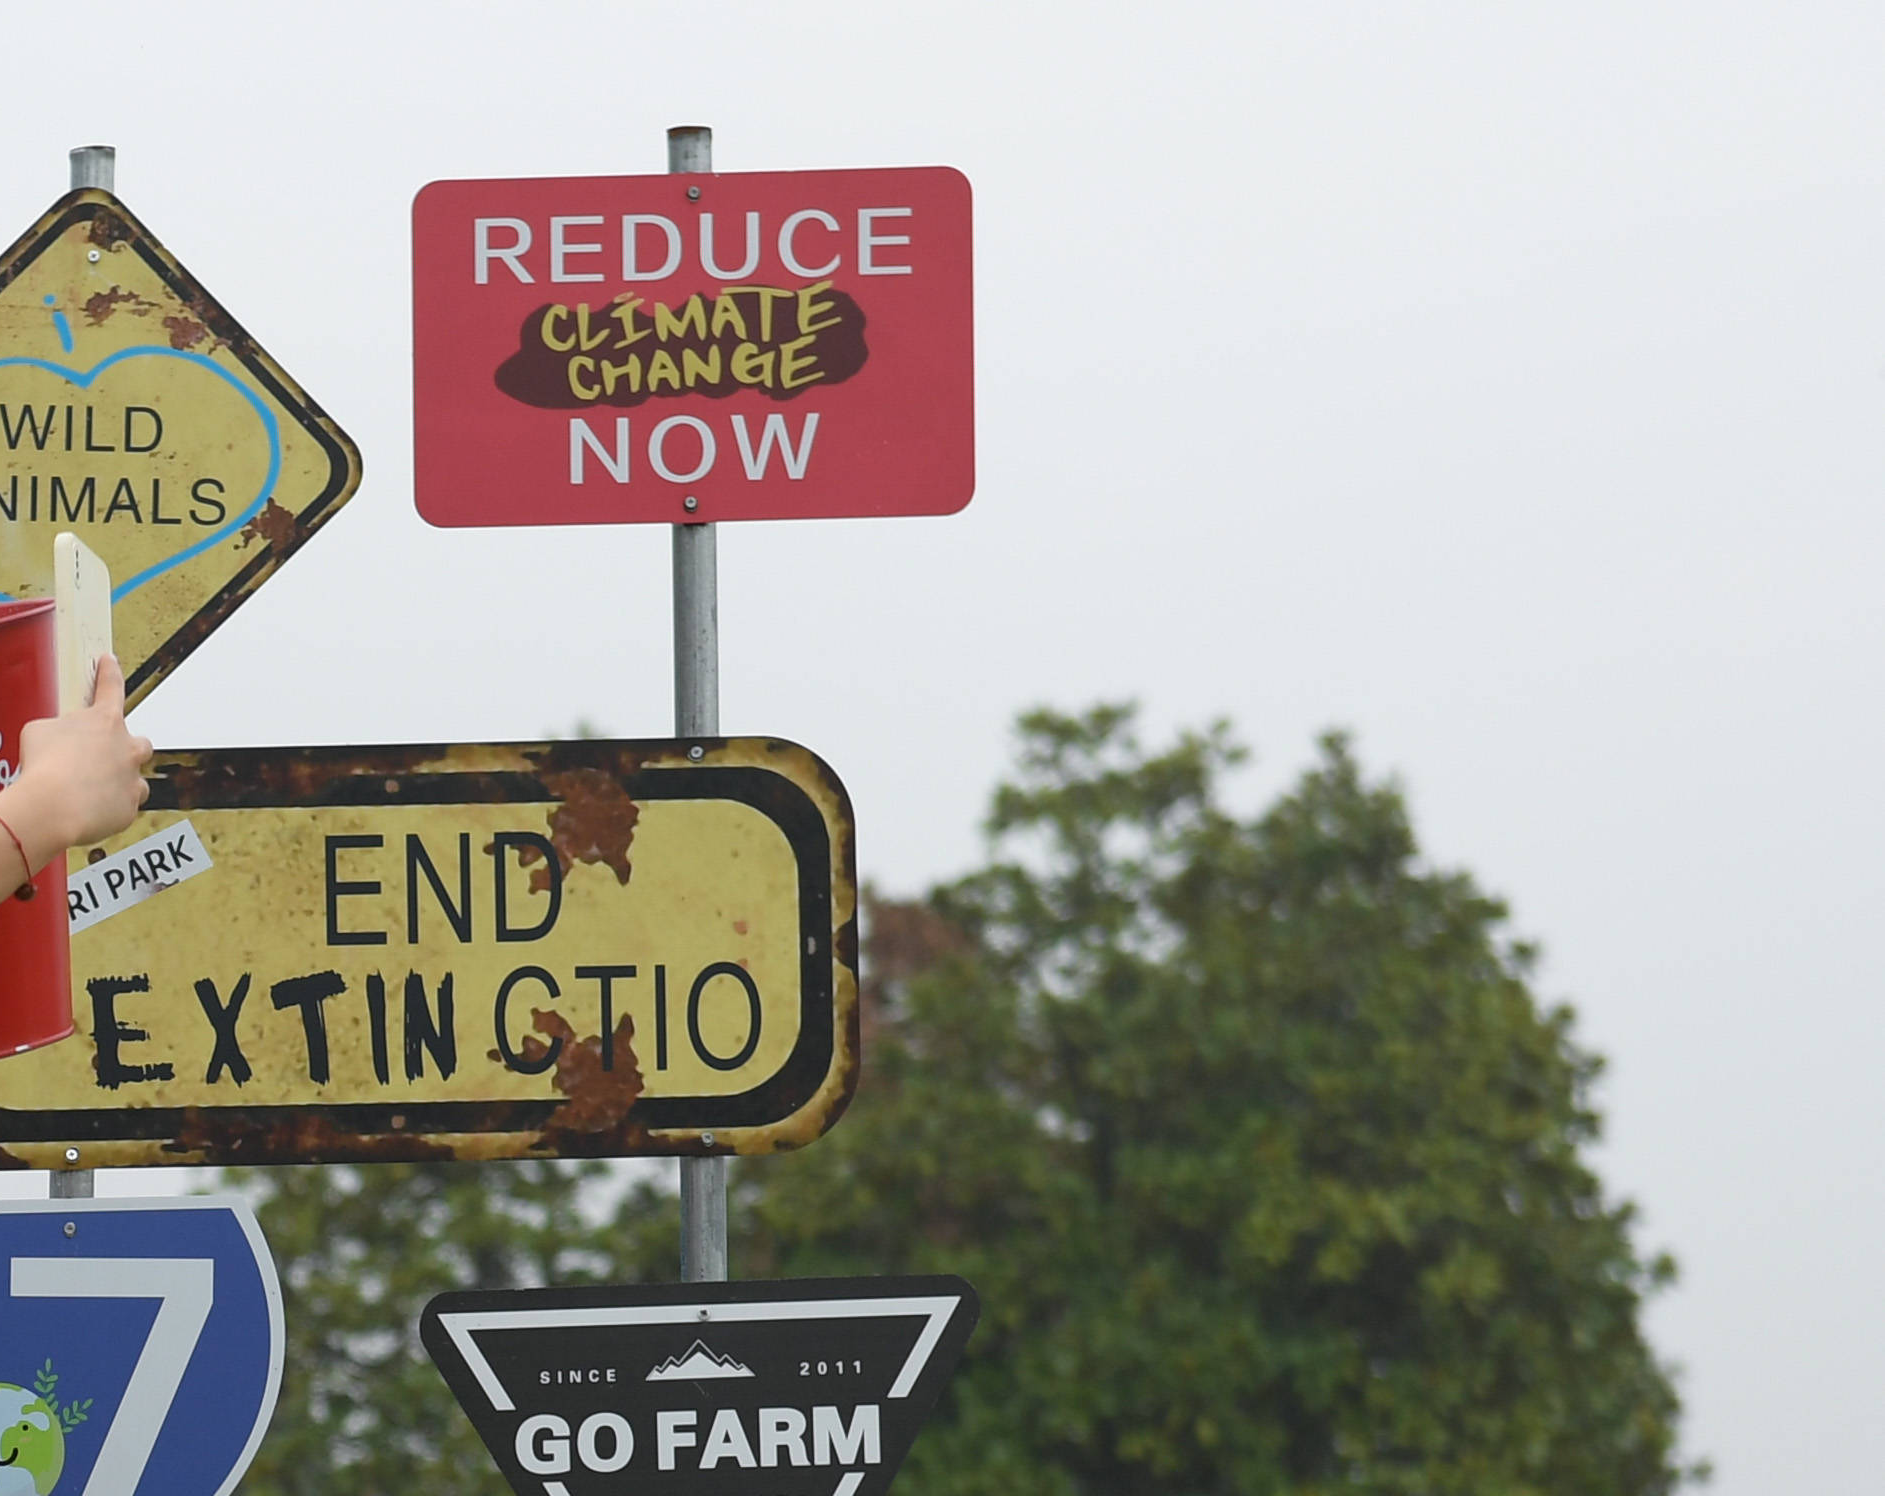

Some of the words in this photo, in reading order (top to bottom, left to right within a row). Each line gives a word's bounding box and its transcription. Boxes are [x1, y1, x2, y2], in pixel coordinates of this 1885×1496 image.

[473, 206, 914, 285] REDUCE
[539, 279, 843, 352] CLIMATE
[567, 334, 826, 400] CHANGE
[0, 403, 164, 454] WILD
[569, 411, 821, 486] NOW
[103, 834, 194, 900] PARK
[325, 830, 563, 946] END
[539, 1368, 618, 1385] SINCE
[799, 1359, 864, 1377] 2011
[514, 1412, 635, 1474] GO
[656, 1404, 882, 1471] FARM
